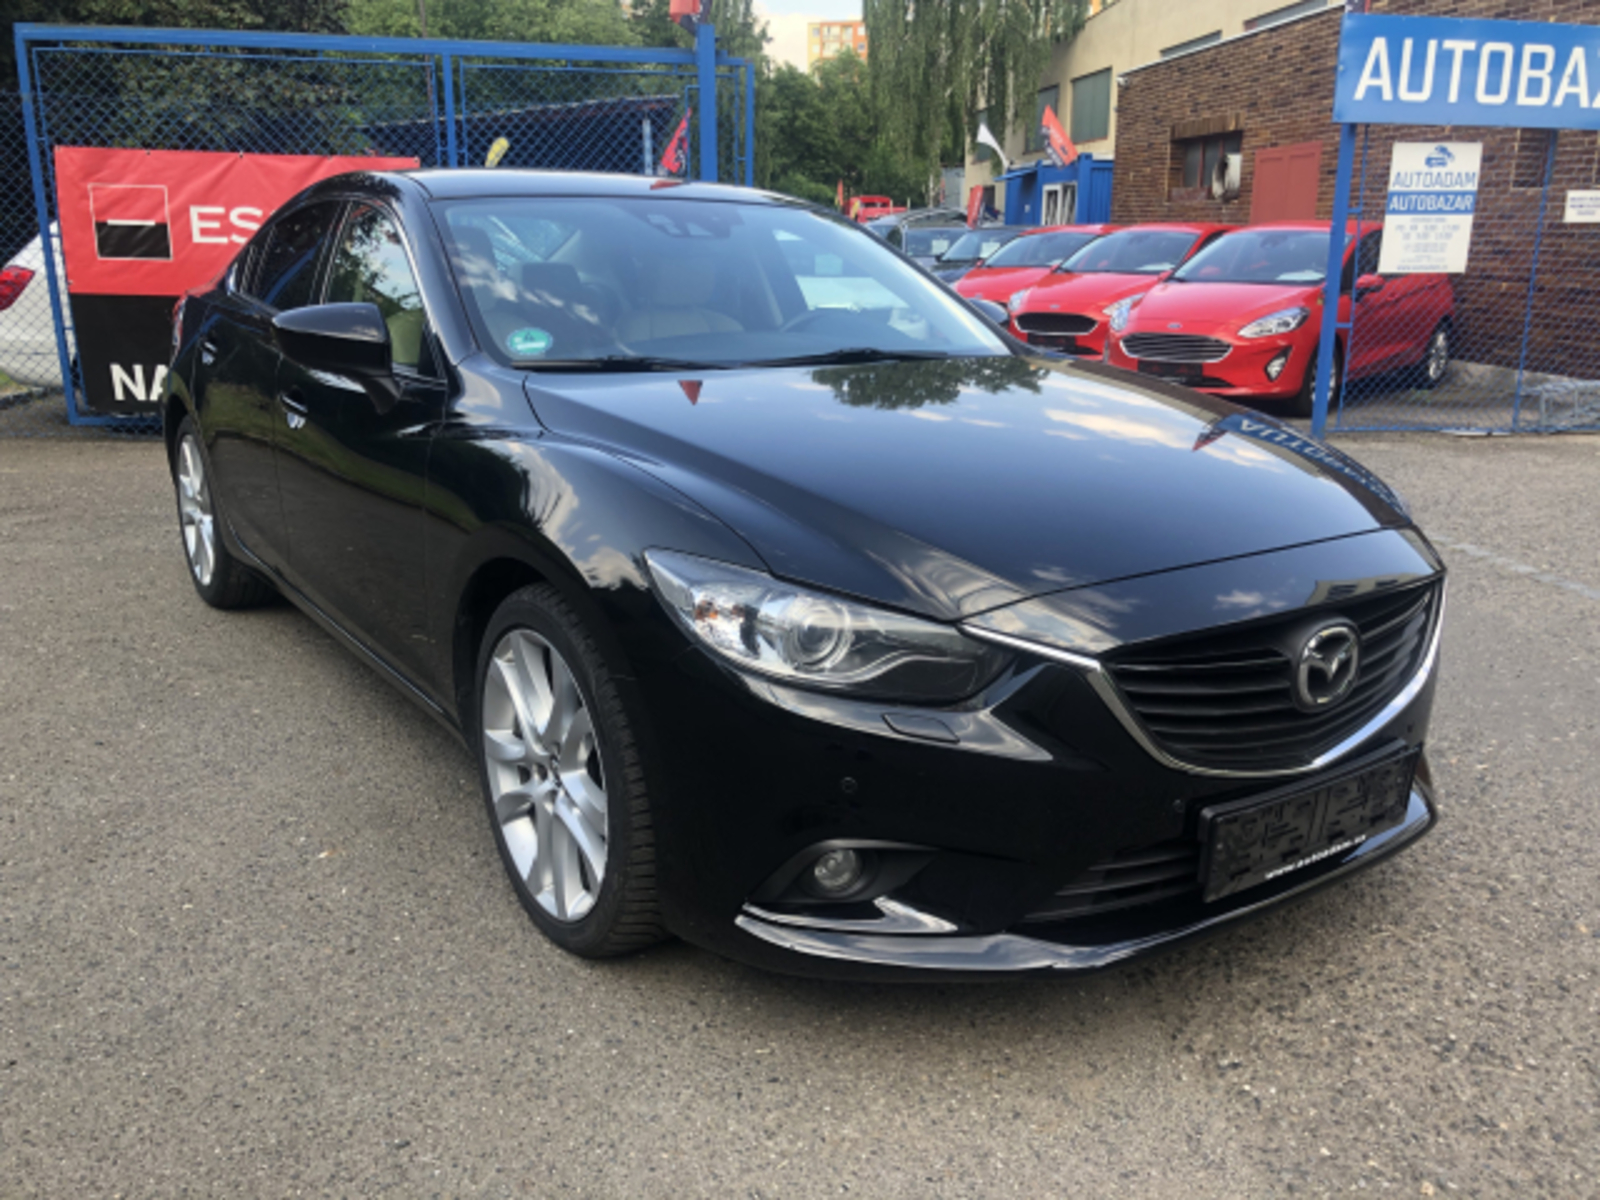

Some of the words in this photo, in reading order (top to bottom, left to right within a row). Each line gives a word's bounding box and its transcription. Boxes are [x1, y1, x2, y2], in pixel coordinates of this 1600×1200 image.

[1353, 36, 1600, 109] AUTOBA
[1392, 171, 1476, 188] AUTOADAM
[1389, 194, 1473, 211] AUTOBAZAR
[189, 205, 277, 245] ES
